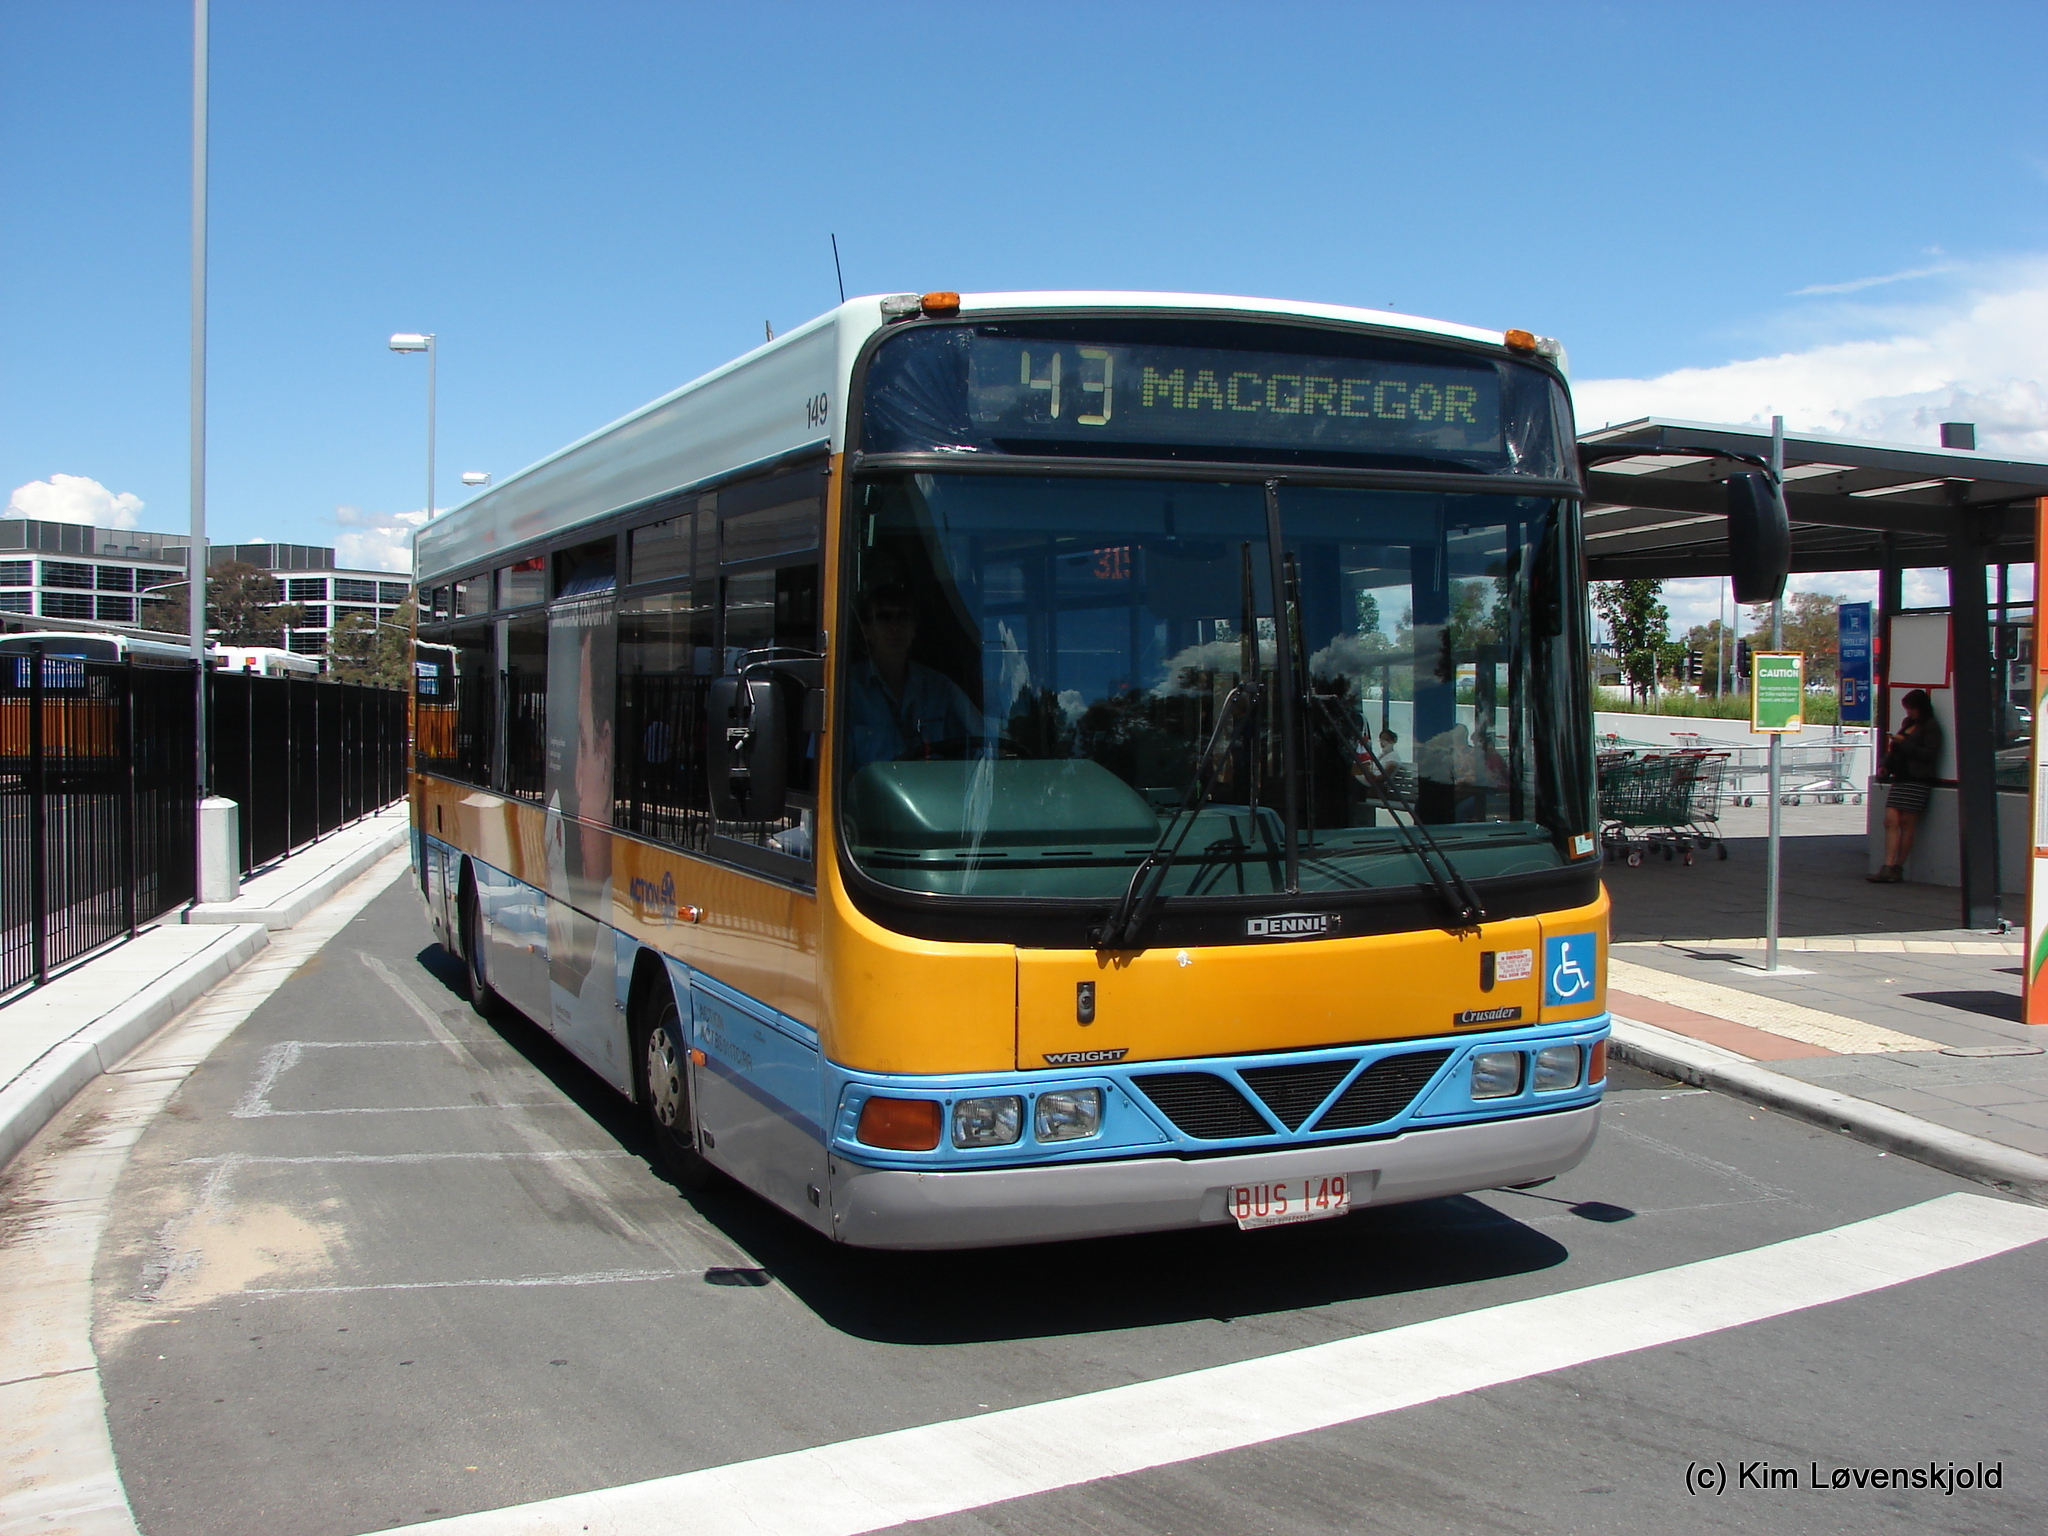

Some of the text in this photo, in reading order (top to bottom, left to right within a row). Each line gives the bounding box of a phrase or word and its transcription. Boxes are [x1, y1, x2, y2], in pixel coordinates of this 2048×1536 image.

[1021, 350, 1477, 425] 43 MACGREGOR
[806, 392, 828, 430] 149
[1842, 638, 1867, 646] TROLLEY
[1843, 649, 1865, 657] RETURN
[1758, 668, 1799, 678] CAUTION
[630, 876, 660, 909] ACTION
[1461, 1006, 1515, 1023] Crusader
[1045, 1049, 1126, 1063] WRIGHT
[1236, 1176, 1345, 1219] BUS 149
